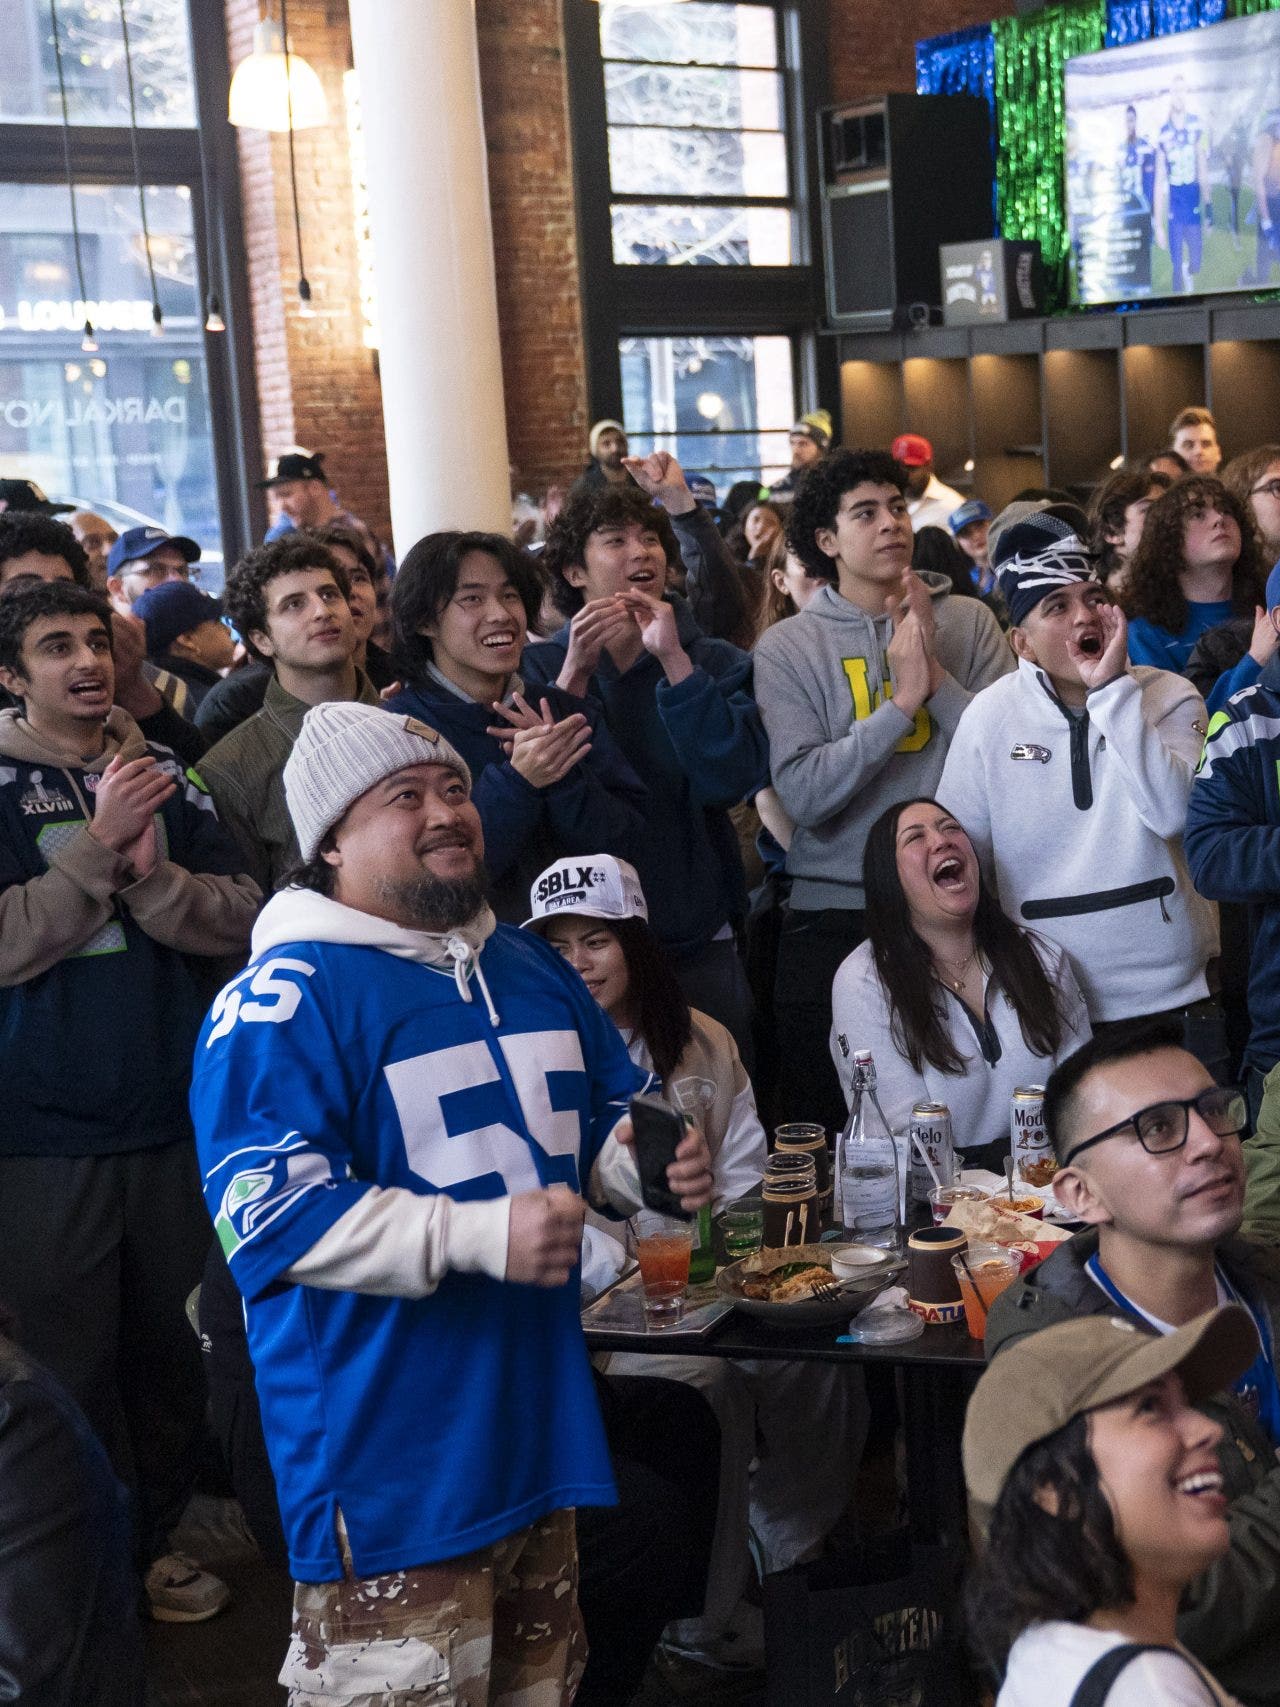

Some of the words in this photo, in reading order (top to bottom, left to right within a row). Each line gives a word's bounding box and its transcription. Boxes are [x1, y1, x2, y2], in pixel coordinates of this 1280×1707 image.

[21, 799, 74, 816] XLVIII
[538, 866, 594, 902] SBLX
[562, 896, 581, 907] AREA
[207, 957, 316, 1049] 55
[383, 1029, 586, 1202] 55
[1015, 1109, 1047, 1127] Mod
